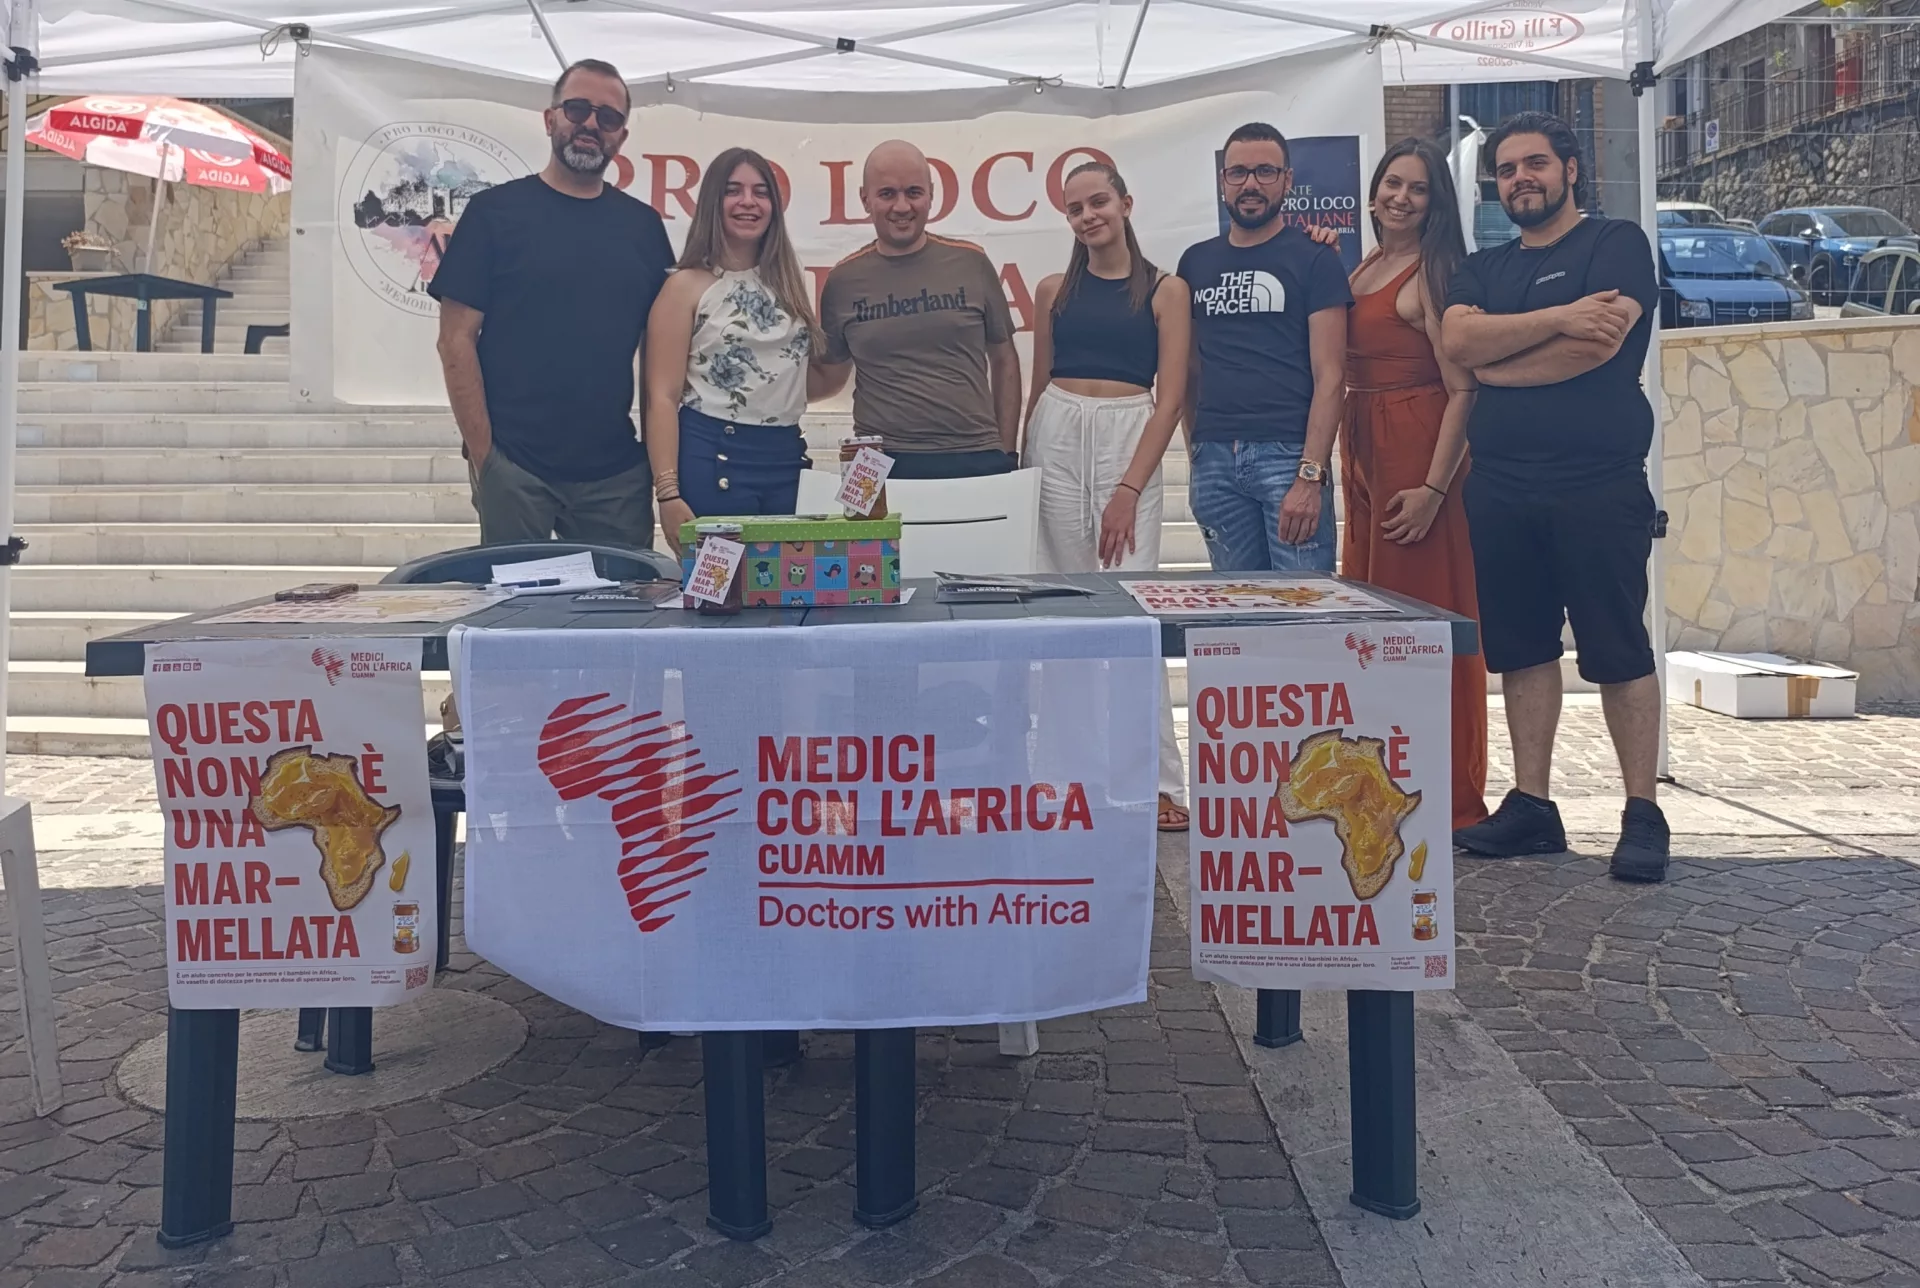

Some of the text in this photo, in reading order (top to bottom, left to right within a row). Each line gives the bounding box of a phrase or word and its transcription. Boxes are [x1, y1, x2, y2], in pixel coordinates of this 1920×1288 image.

[70, 114, 127, 134] ALGIDA
[383, 125, 504, 159] PRO LOCO ARENA
[1313, 196, 1356, 210] LOCO
[1194, 285, 1251, 304] NORTH
[1220, 270, 1253, 287] THE
[852, 286, 967, 323] Timberland
[1206, 299, 1250, 316] FACE
[856, 463, 879, 478] QUESTA
[841, 492, 867, 510] MELLATA
[704, 553, 729, 566] QUESTA
[691, 584, 720, 599] MELLATA
[350, 652, 384, 662] MEDICI
[1383, 636, 1415, 646] MEDICI
[1383, 645, 1444, 655] CON L'AFRICA
[350, 661, 412, 672] CON L'AFRICA
[157, 699, 323, 756] QUESTA
[1196, 682, 1354, 741] QUESTA
[164, 743, 387, 799] NON È
[759, 735, 935, 783] MEDICI
[1199, 726, 1411, 785] NON È
[758, 783, 1094, 837] CON L'AFRICA
[1199, 797, 1289, 839] UNA
[173, 808, 266, 849] UNA
[758, 844, 884, 876] CUAMM
[1200, 851, 1322, 893] MAR-
[175, 861, 300, 906] MAR-
[759, 892, 1090, 930] Doctors with Africa
[1201, 904, 1380, 947] MELLATA
[177, 915, 359, 962] MELLATA
